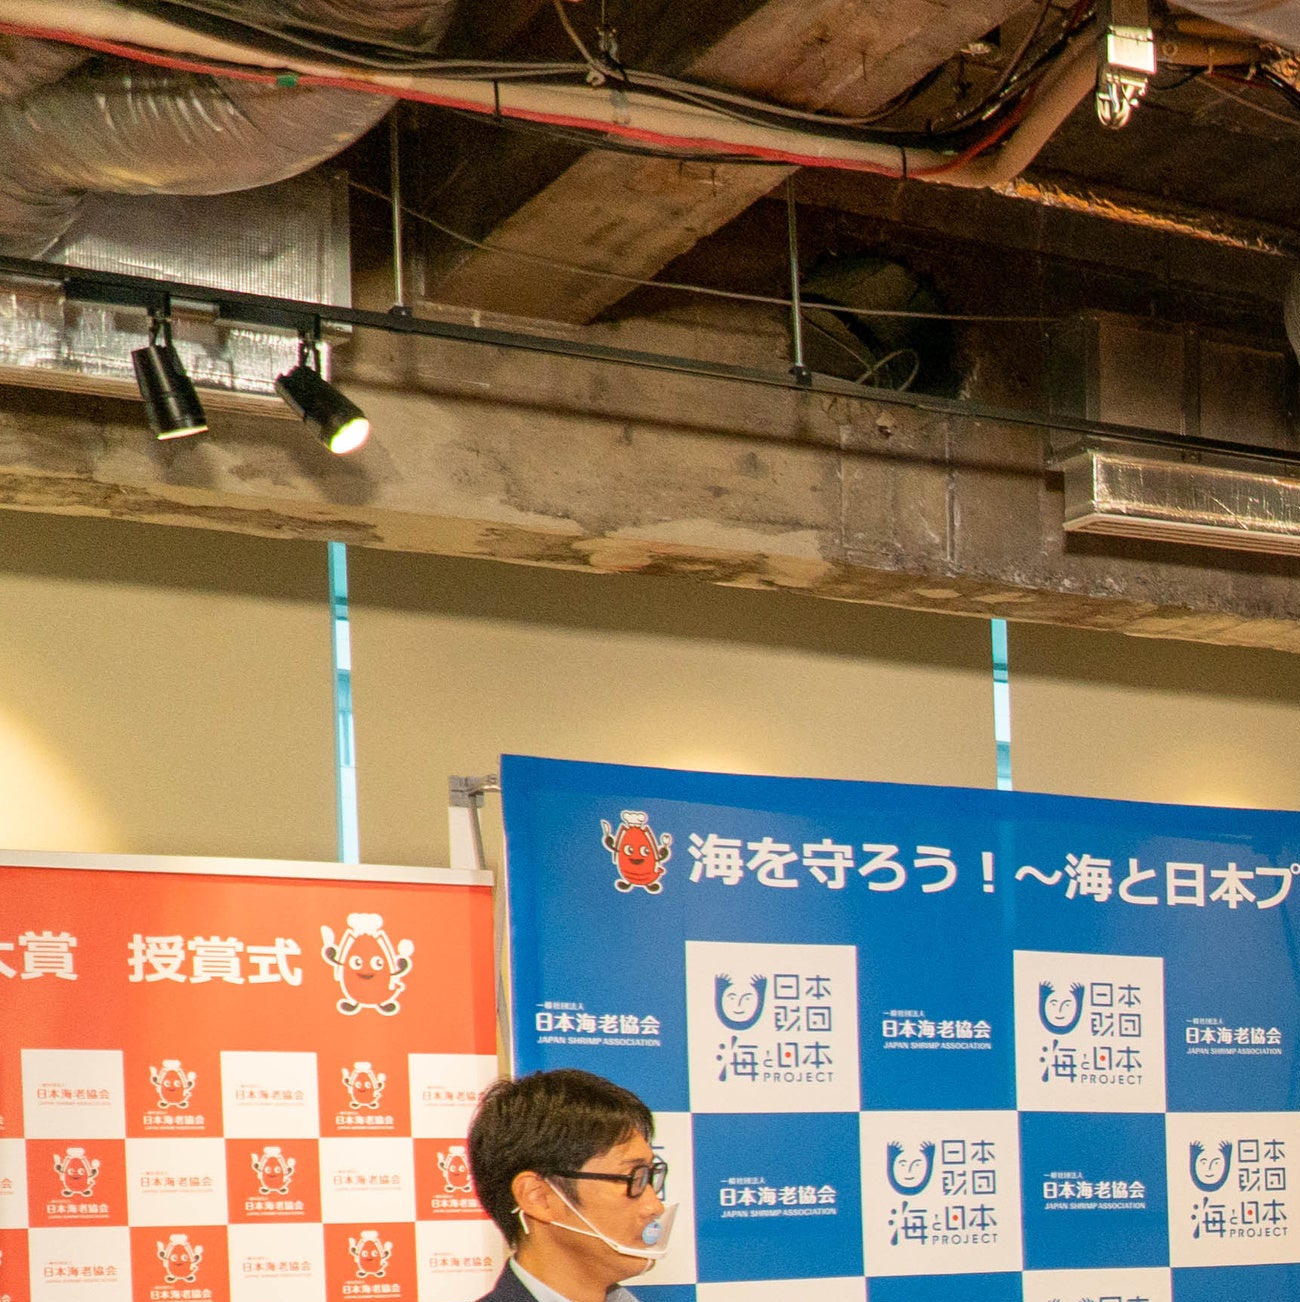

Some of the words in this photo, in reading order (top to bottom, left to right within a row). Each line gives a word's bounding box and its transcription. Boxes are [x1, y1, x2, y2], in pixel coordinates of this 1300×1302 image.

[128, 934, 302, 987] 授賞式
[773, 973, 832, 1001] 日本
[1090, 982, 1141, 1008] 日本
[535, 1012, 661, 1036] 日本海老協会
[774, 1005, 833, 1032] 財団
[882, 1019, 992, 1039] 日本海老協会
[1090, 1011, 1142, 1038] 財団
[537, 1036, 566, 1044] JAPAN
[568, 1037, 602, 1045] SHRIMP
[602, 1038, 660, 1047] ASSOCIATION
[1185, 1026, 1282, 1045] 日本海老協会
[716, 1035, 833, 1082] 海と日本
[1039, 1038, 1143, 1083] 海と日本
[763, 1071, 834, 1083] PROJECT
[1080, 1073, 1143, 1085] PROJECT
[36, 1088, 109, 1100] 日本海老協会
[235, 1089, 303, 1101] 日本海老協会
[143, 1114, 205, 1126] 日本海老協会
[335, 1115, 394, 1126] 日本海老協会
[941, 1139, 995, 1165] 日本
[1237, 1139, 1286, 1164] 日本
[140, 1176, 211, 1187] 日本海老協会
[942, 1169, 997, 1196] 財団
[1043, 1180, 1146, 1199] 日本海老協会
[1238, 1167, 1287, 1192] 財団
[720, 1184, 837, 1207] 日本海老協会
[888, 1200, 998, 1246] 海と日本
[1191, 1196, 1288, 1240] 海と日本
[932, 1232, 998, 1245] PROJECT
[1229, 1226, 1288, 1238] PROJECT
[44, 1265, 116, 1277] 日本海老協会
